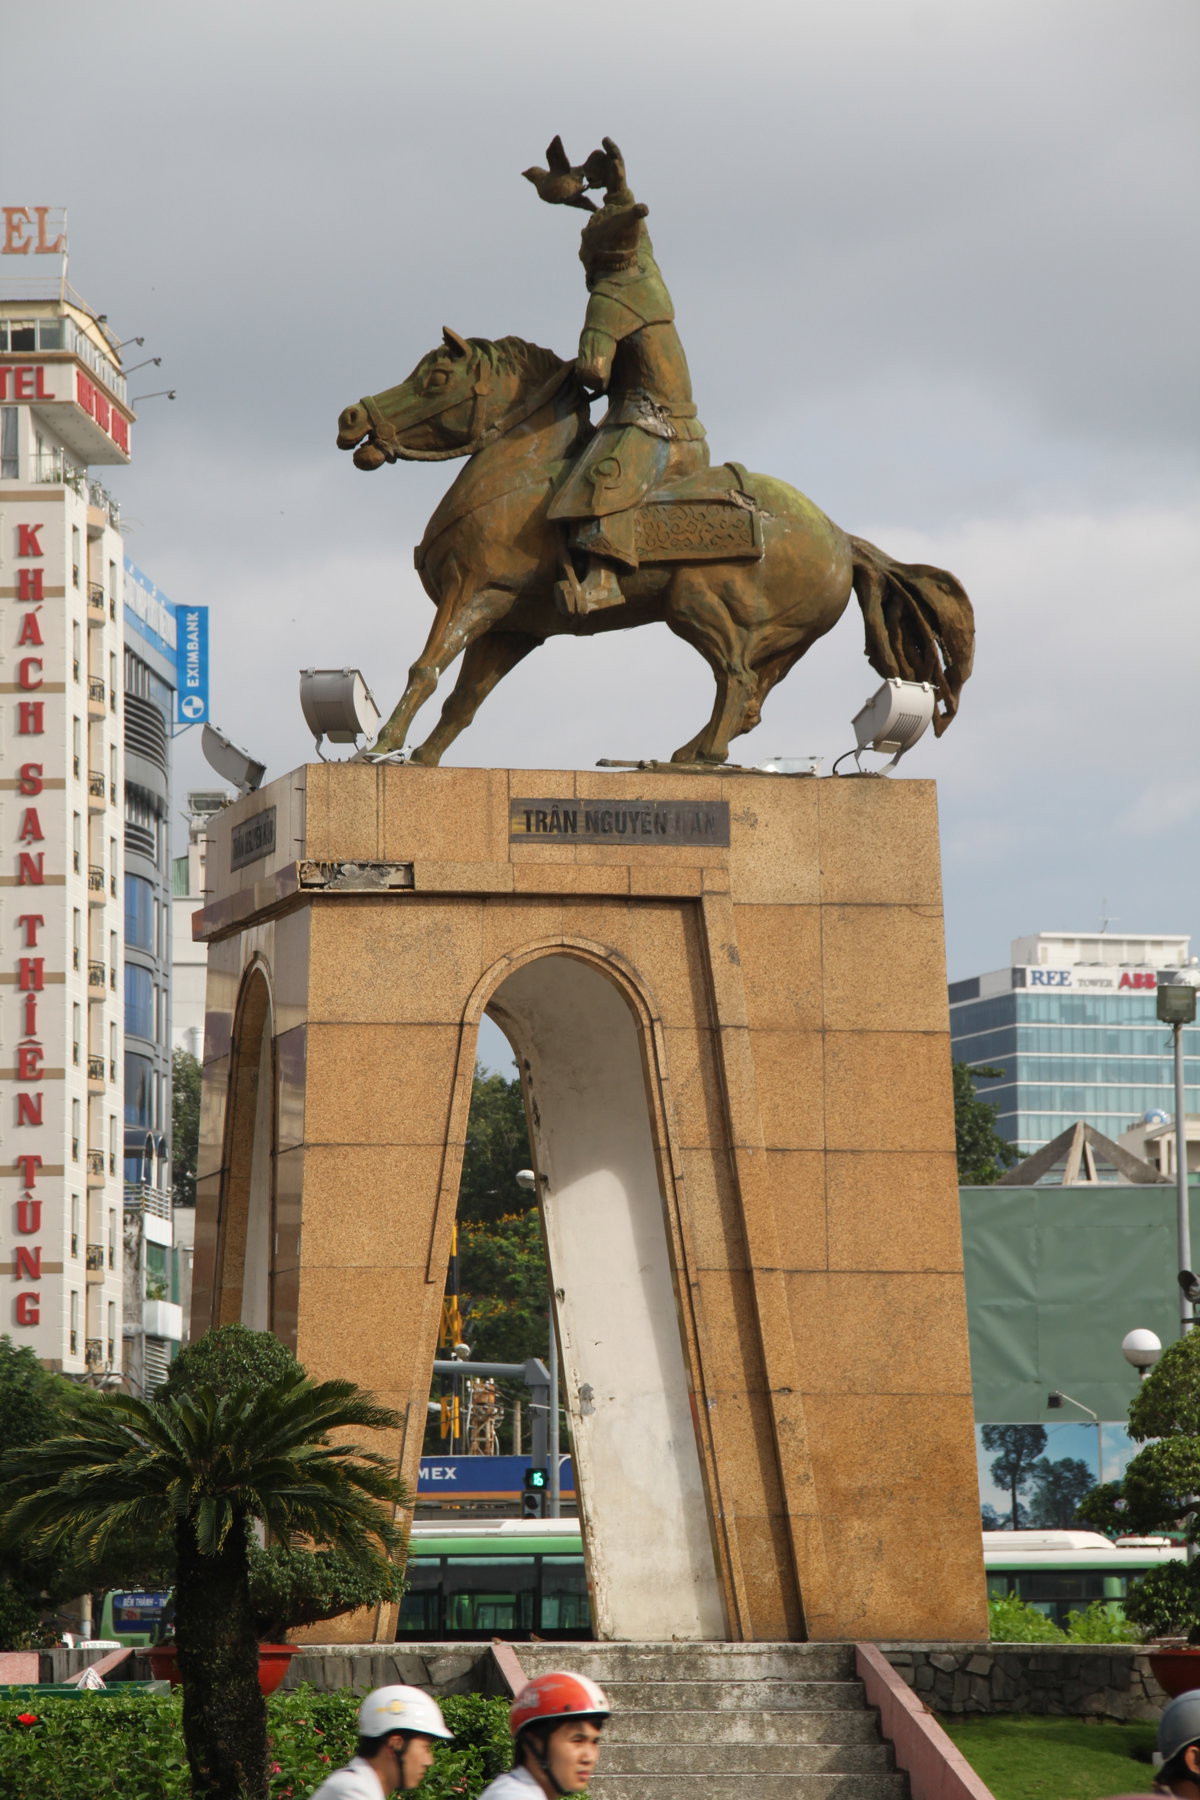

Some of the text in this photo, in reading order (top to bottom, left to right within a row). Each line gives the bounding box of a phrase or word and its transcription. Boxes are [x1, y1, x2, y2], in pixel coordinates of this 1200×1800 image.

[1, 206, 65, 254] EL
[17, 524, 45, 734] KHÁCH
[187, 611, 199, 687] EXIMBANK
[19, 763, 45, 885] SẠN
[1031, 970, 1157, 990] REE TOWER ABB
[15, 1155, 43, 1326] TÙNG
